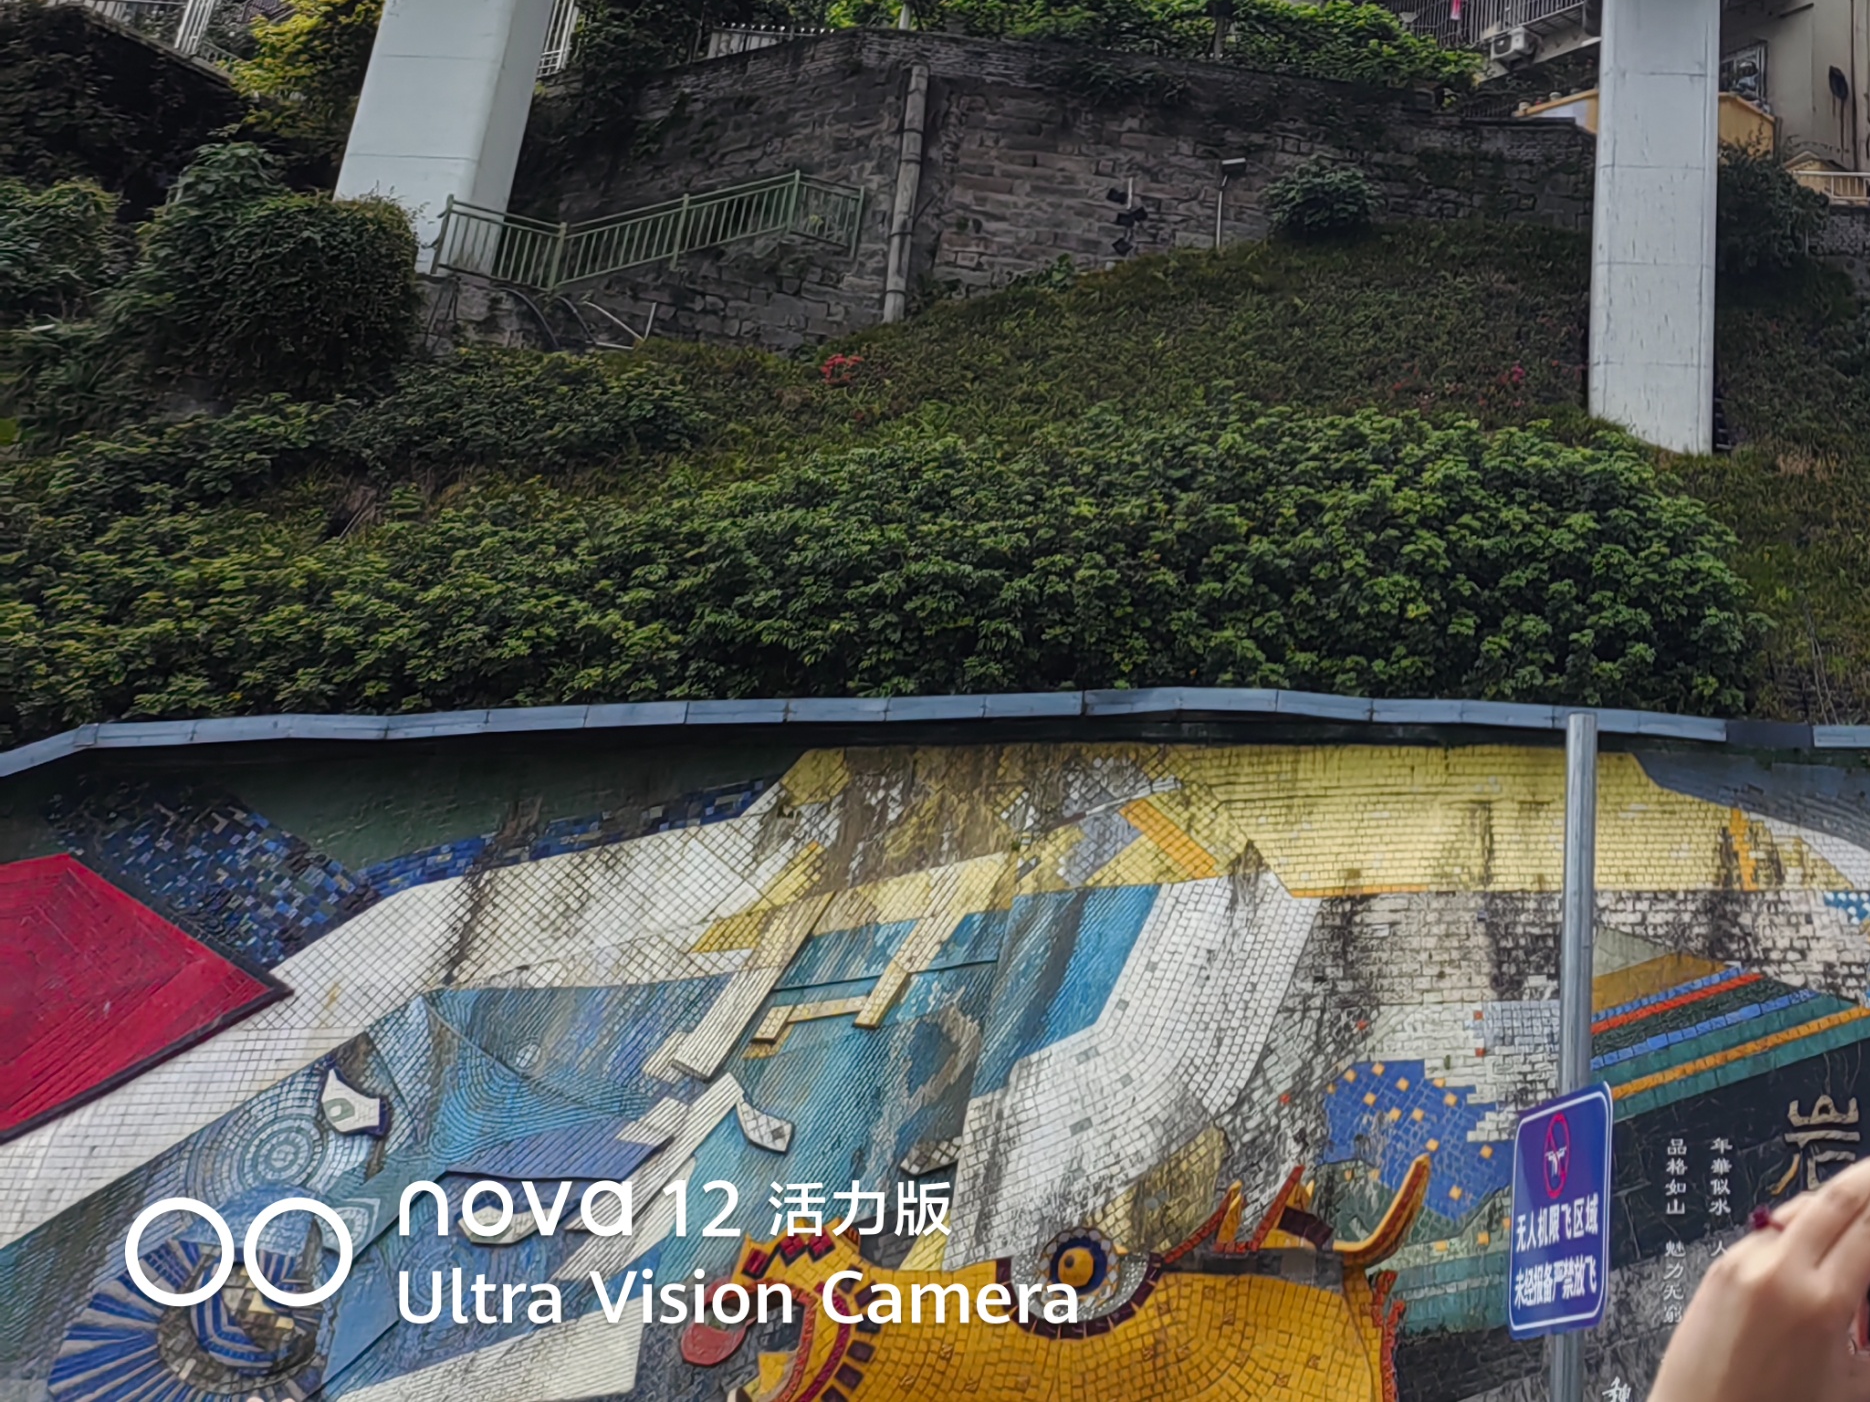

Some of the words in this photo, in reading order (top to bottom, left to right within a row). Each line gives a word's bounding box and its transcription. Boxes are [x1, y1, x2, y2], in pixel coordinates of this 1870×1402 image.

[1665, 1139, 1688, 1215] 品格如山
[1516, 1192, 1599, 1253] 无人机限飞区域
[1514, 1254, 1597, 1311] 未经报备严禁放飞
